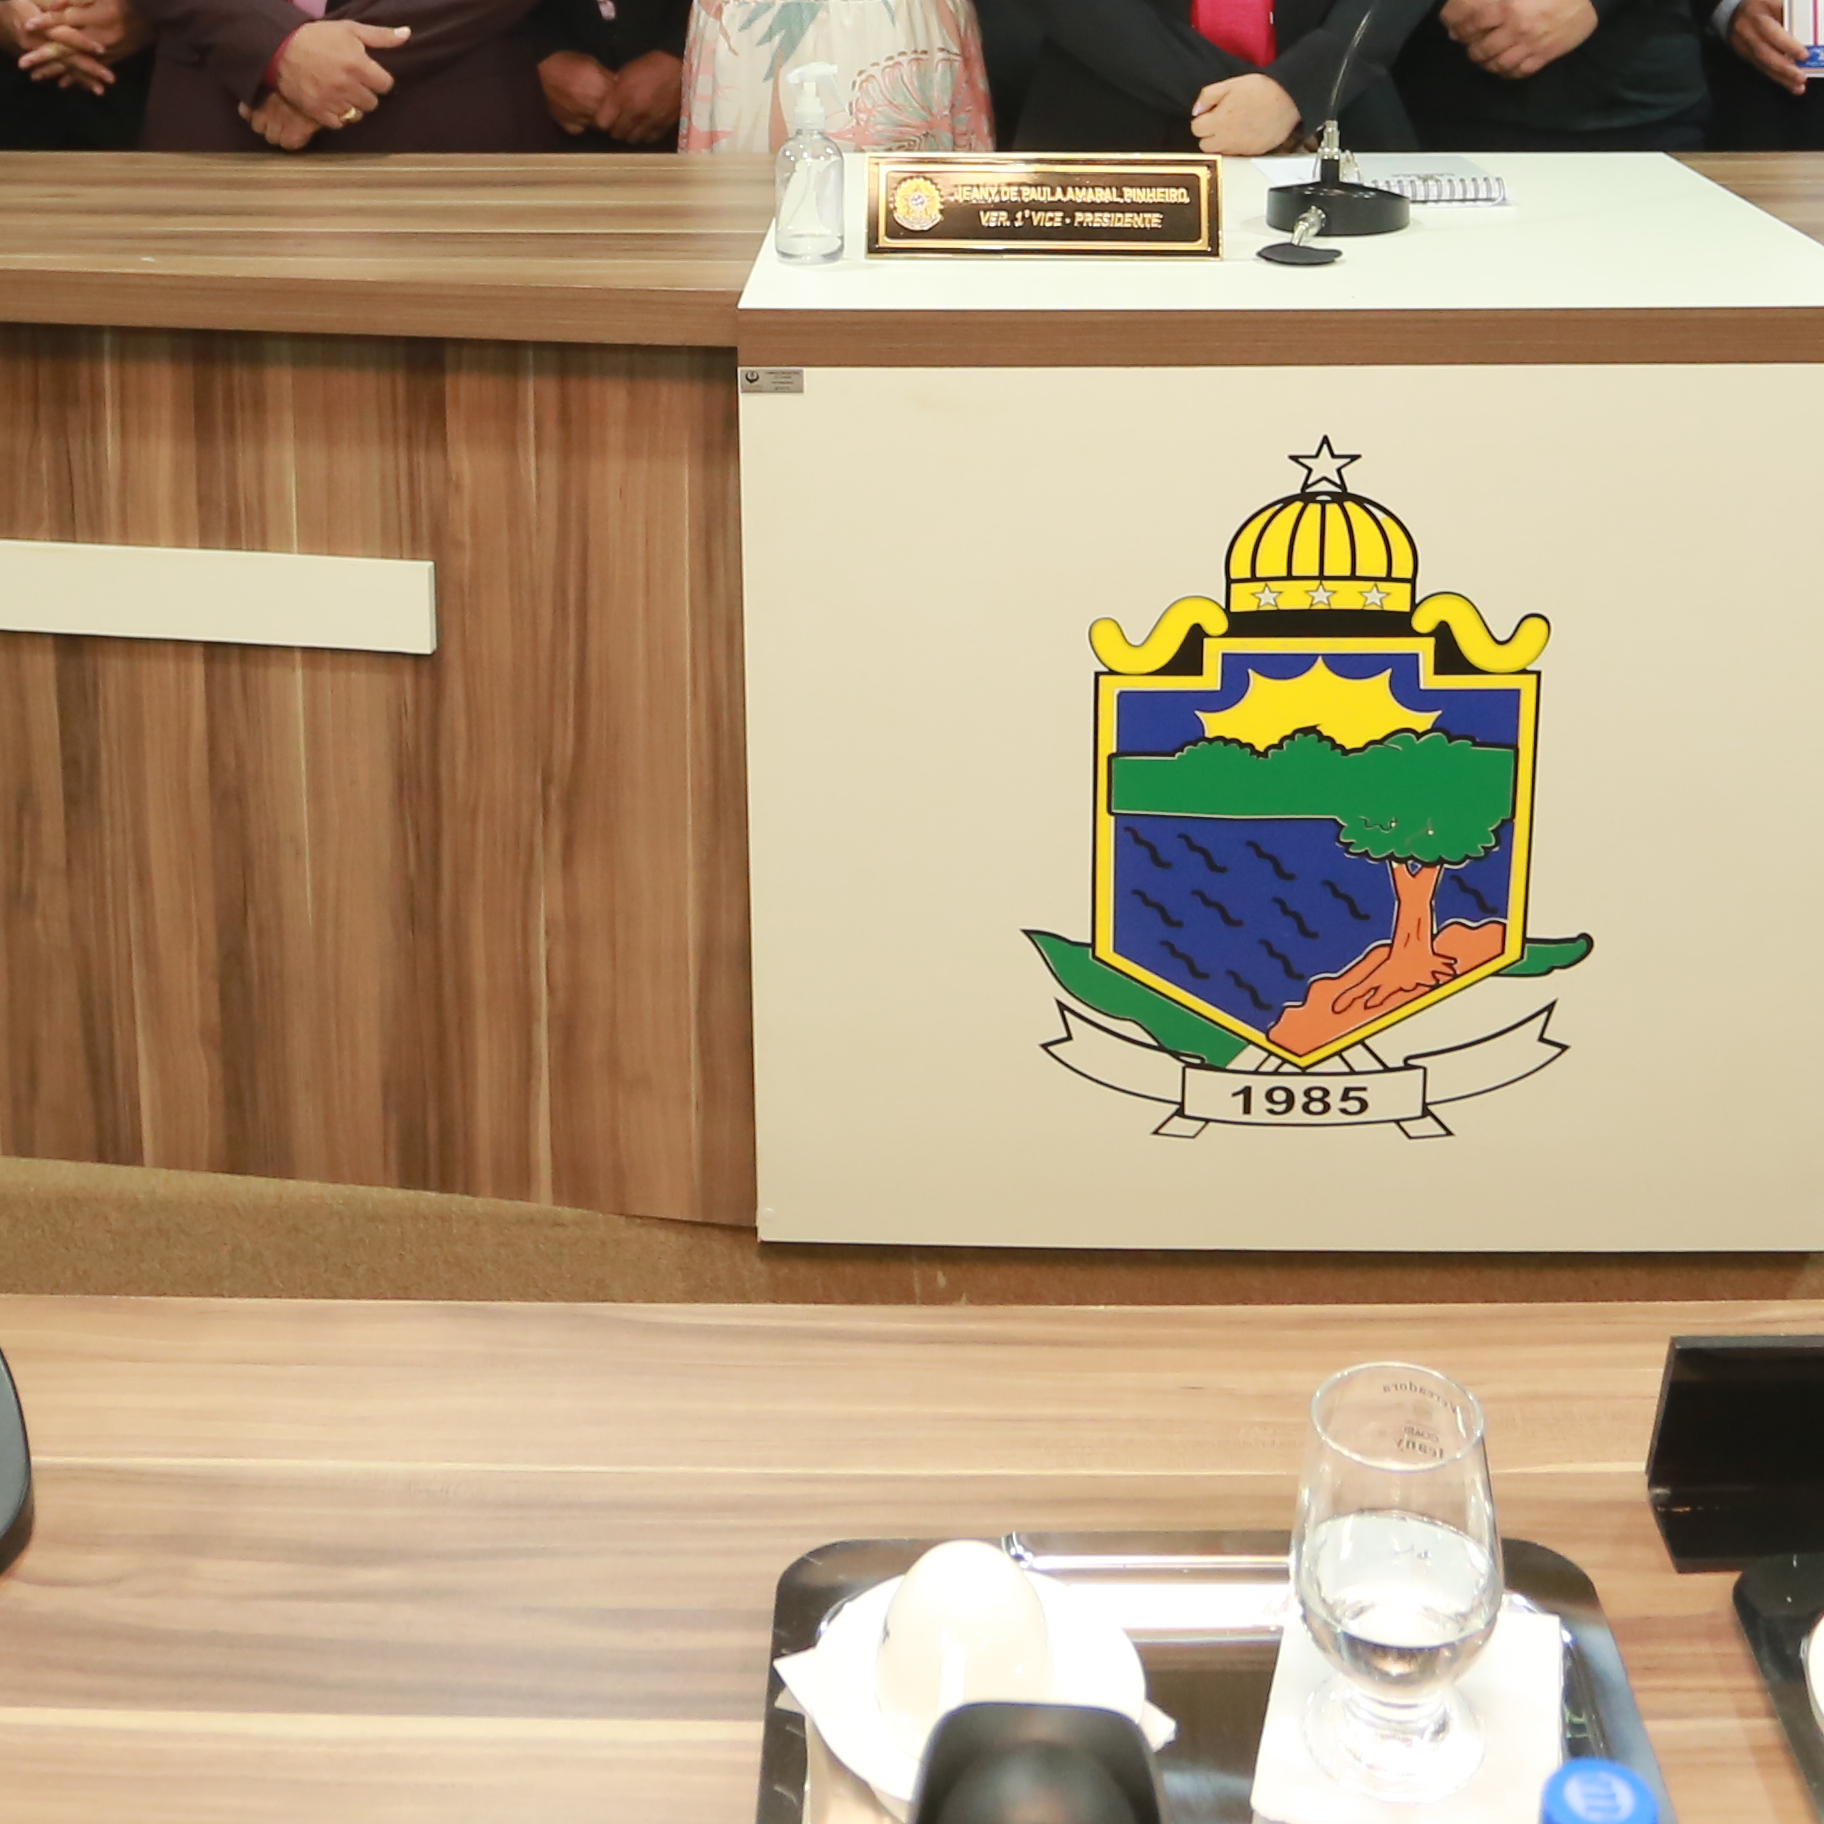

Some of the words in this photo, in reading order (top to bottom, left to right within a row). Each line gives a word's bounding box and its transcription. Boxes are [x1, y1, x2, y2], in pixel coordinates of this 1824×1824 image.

[1001, 186, 1020, 203] DE
[1021, 186, 1063, 204] PAULA
[1062, 186, 1123, 204] AMARAL
[1030, 210, 1064, 228] VICE
[1073, 211, 1164, 230] PRESIDENTE
[1231, 1085, 1369, 1116] 1985
